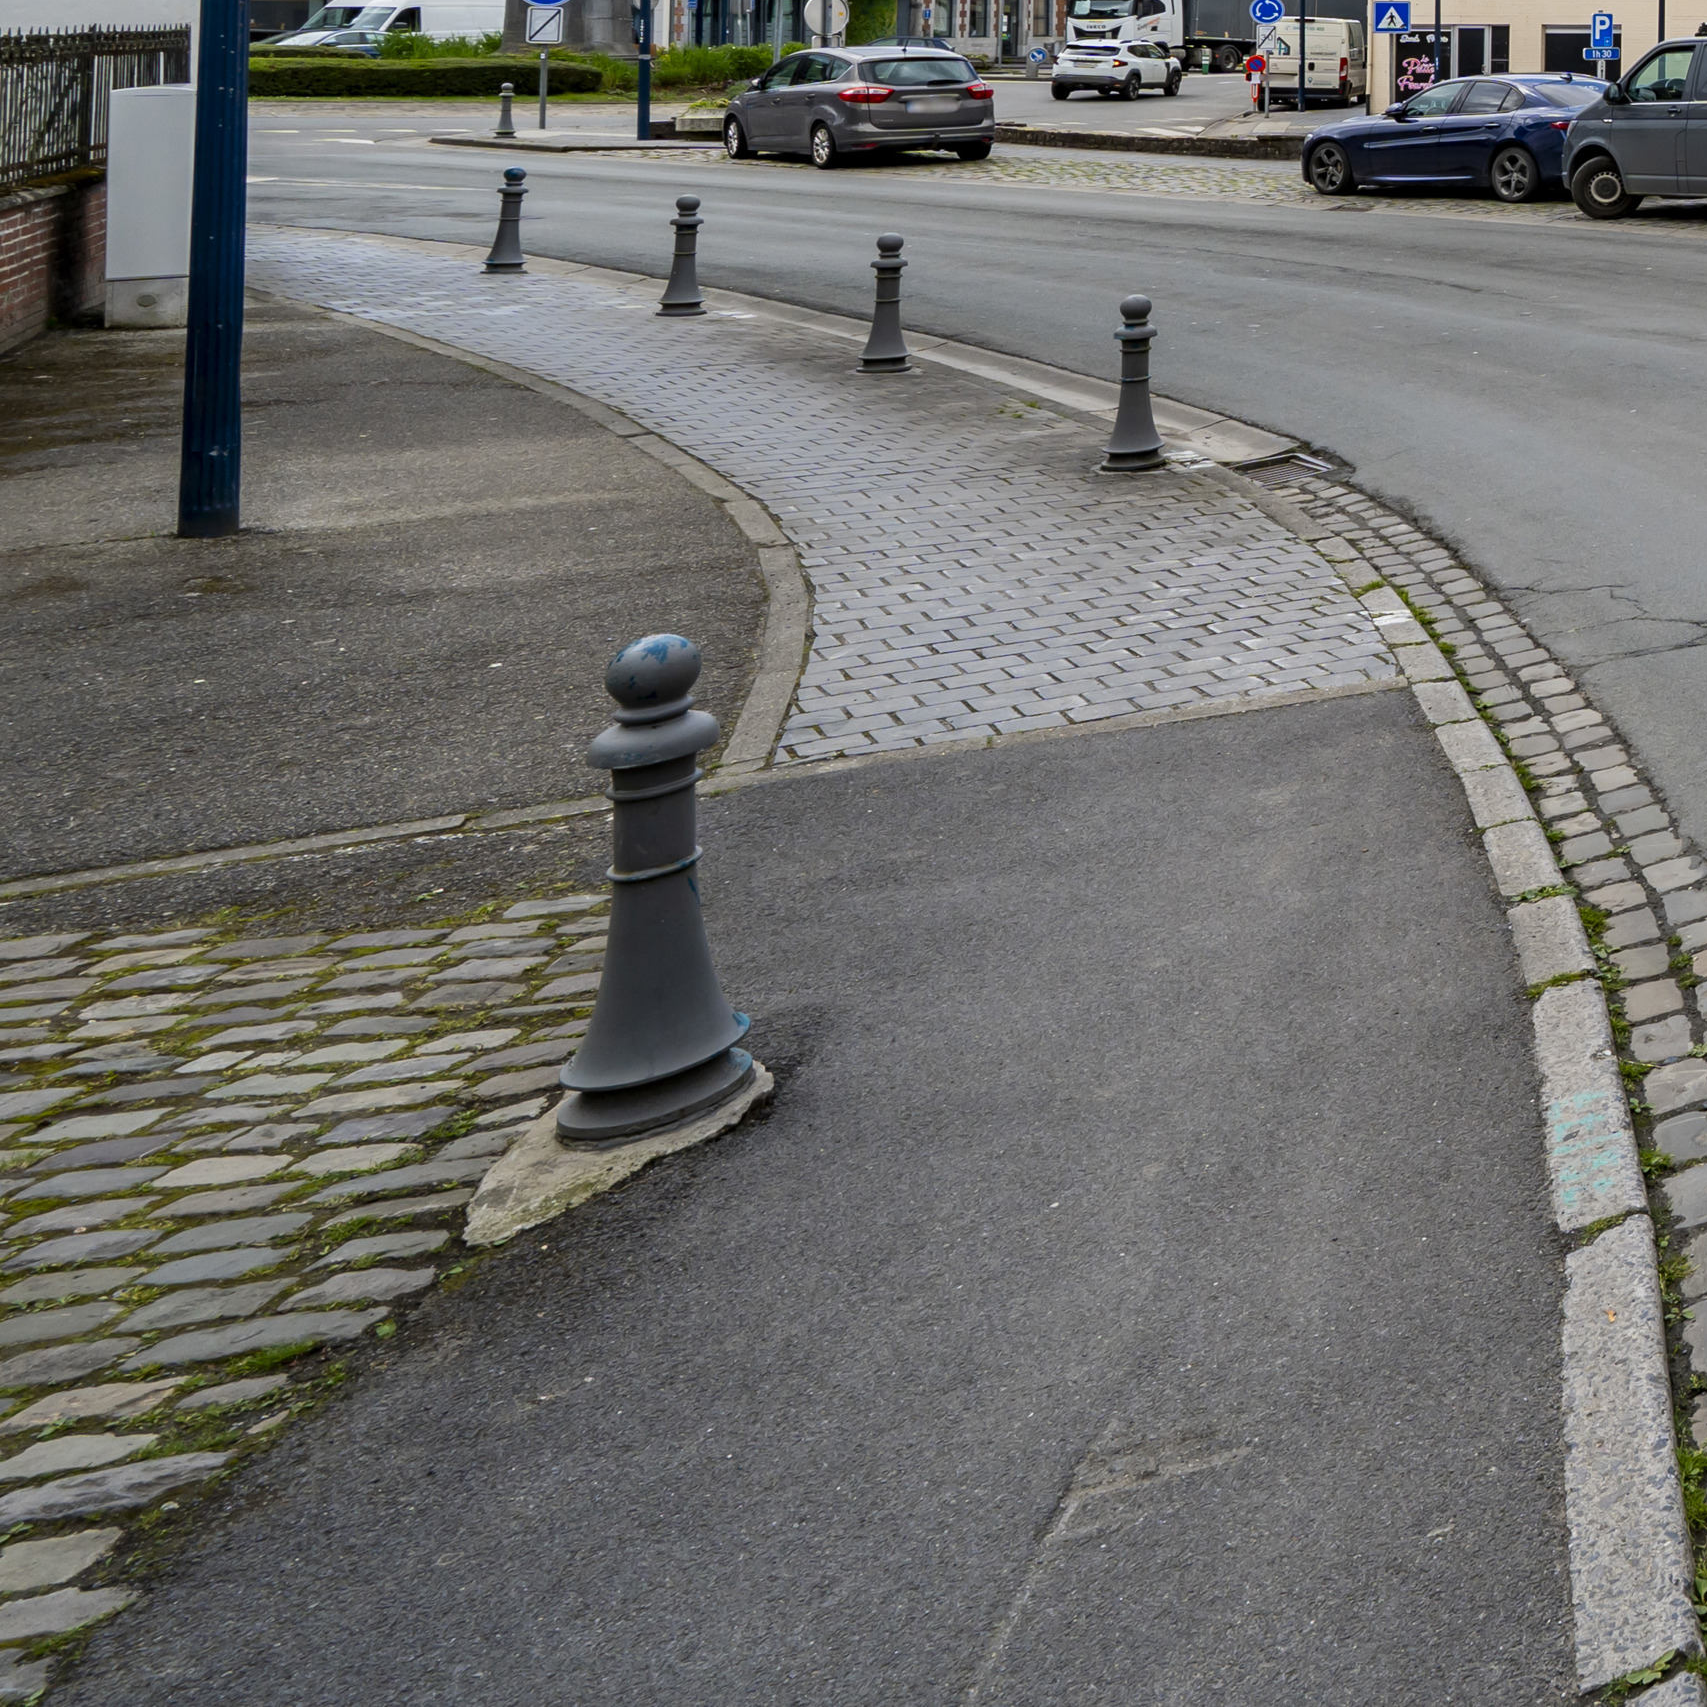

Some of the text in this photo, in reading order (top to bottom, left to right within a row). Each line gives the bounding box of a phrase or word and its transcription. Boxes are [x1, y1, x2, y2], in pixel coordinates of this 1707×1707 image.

[1595, 16, 1610, 39] P
[1592, 49, 1612, 58] 1h 30
